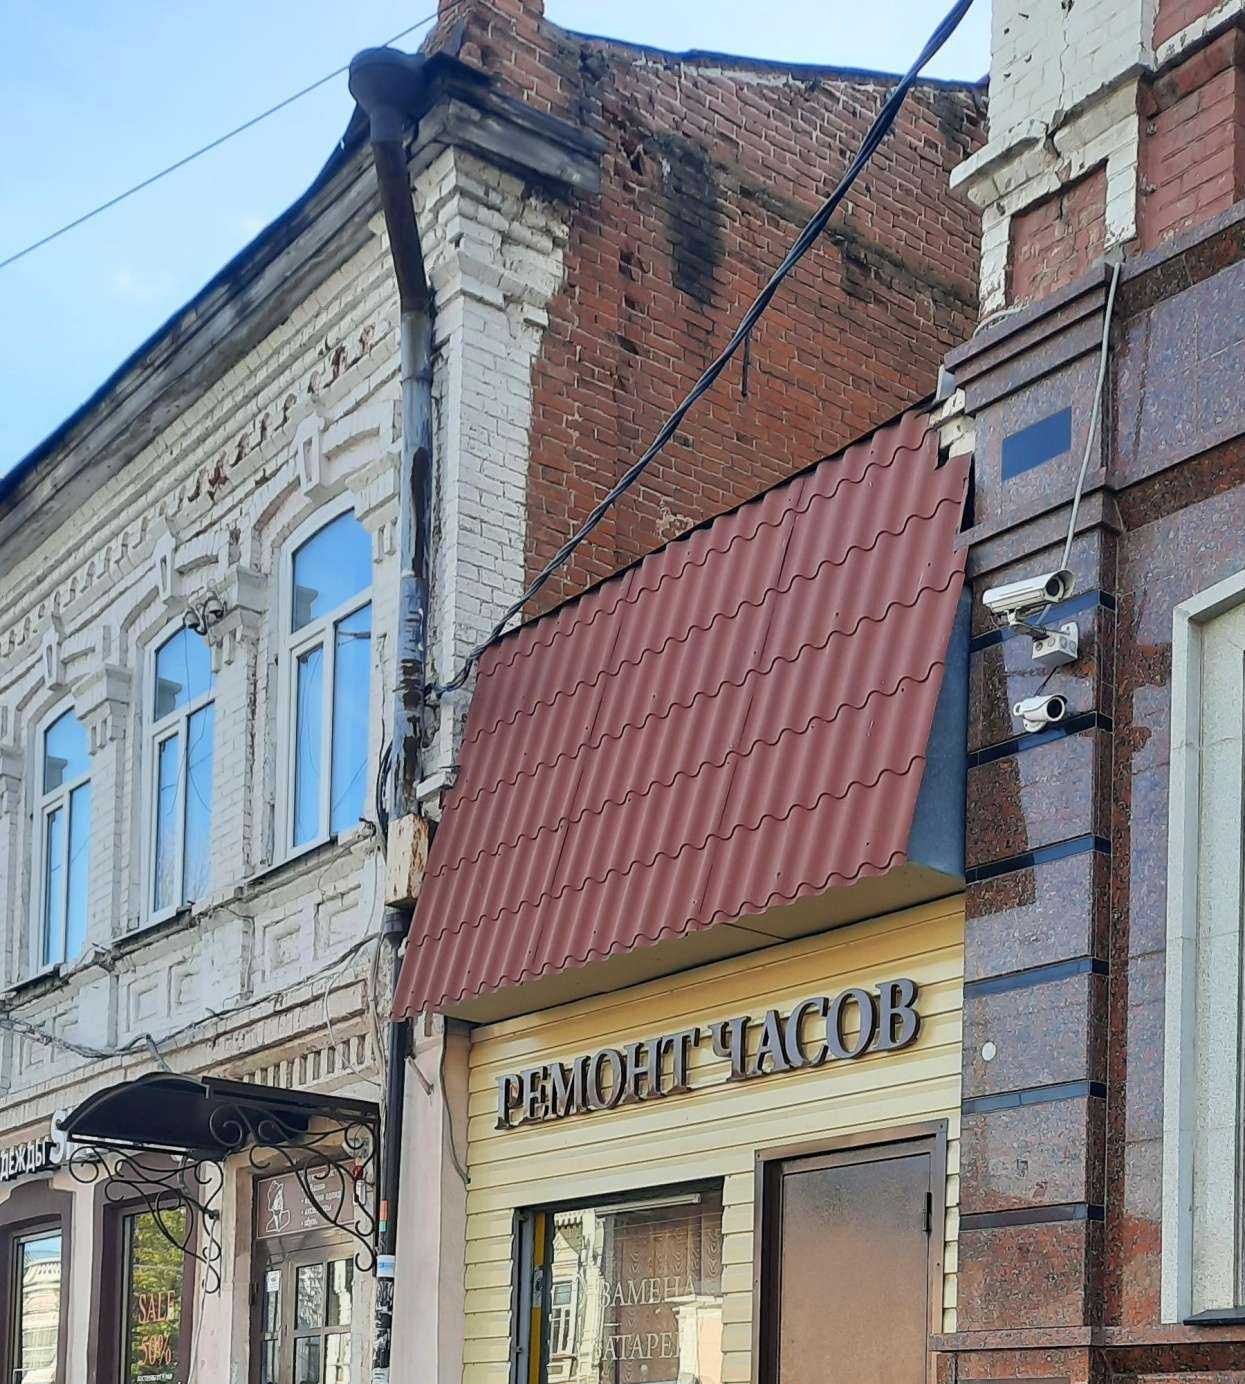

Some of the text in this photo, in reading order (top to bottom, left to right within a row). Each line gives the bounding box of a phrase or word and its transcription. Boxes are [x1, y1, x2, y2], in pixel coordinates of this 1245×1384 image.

[494, 977, 922, 1131] РЕМОНТ ЧАСОВ
[137, 1290, 176, 1325] SALE
[138, 1335, 173, 1366] 50%
